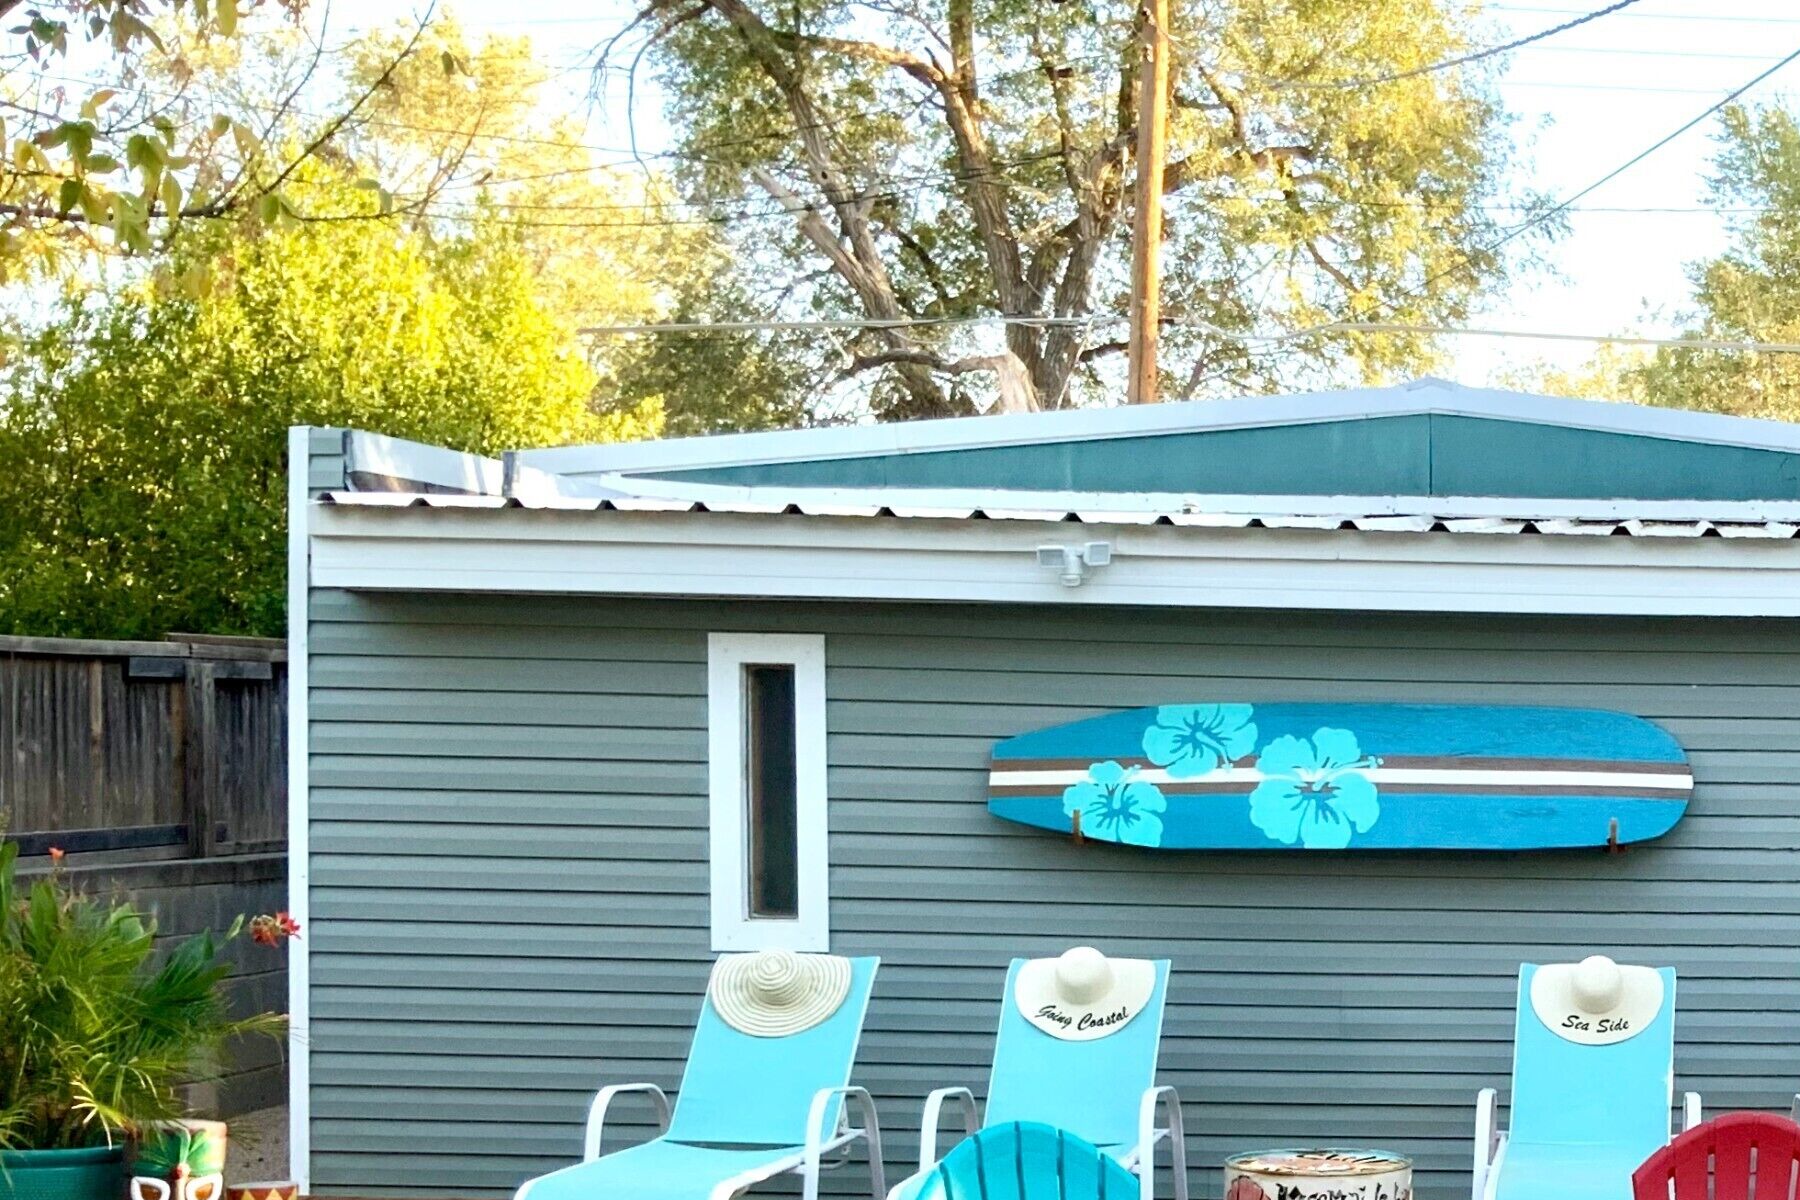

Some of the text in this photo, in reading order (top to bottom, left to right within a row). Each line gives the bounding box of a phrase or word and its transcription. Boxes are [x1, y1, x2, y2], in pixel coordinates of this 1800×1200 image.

[1035, 1005, 1129, 1030] Going Coastal
[1562, 1015, 1630, 1033] Sea Side
